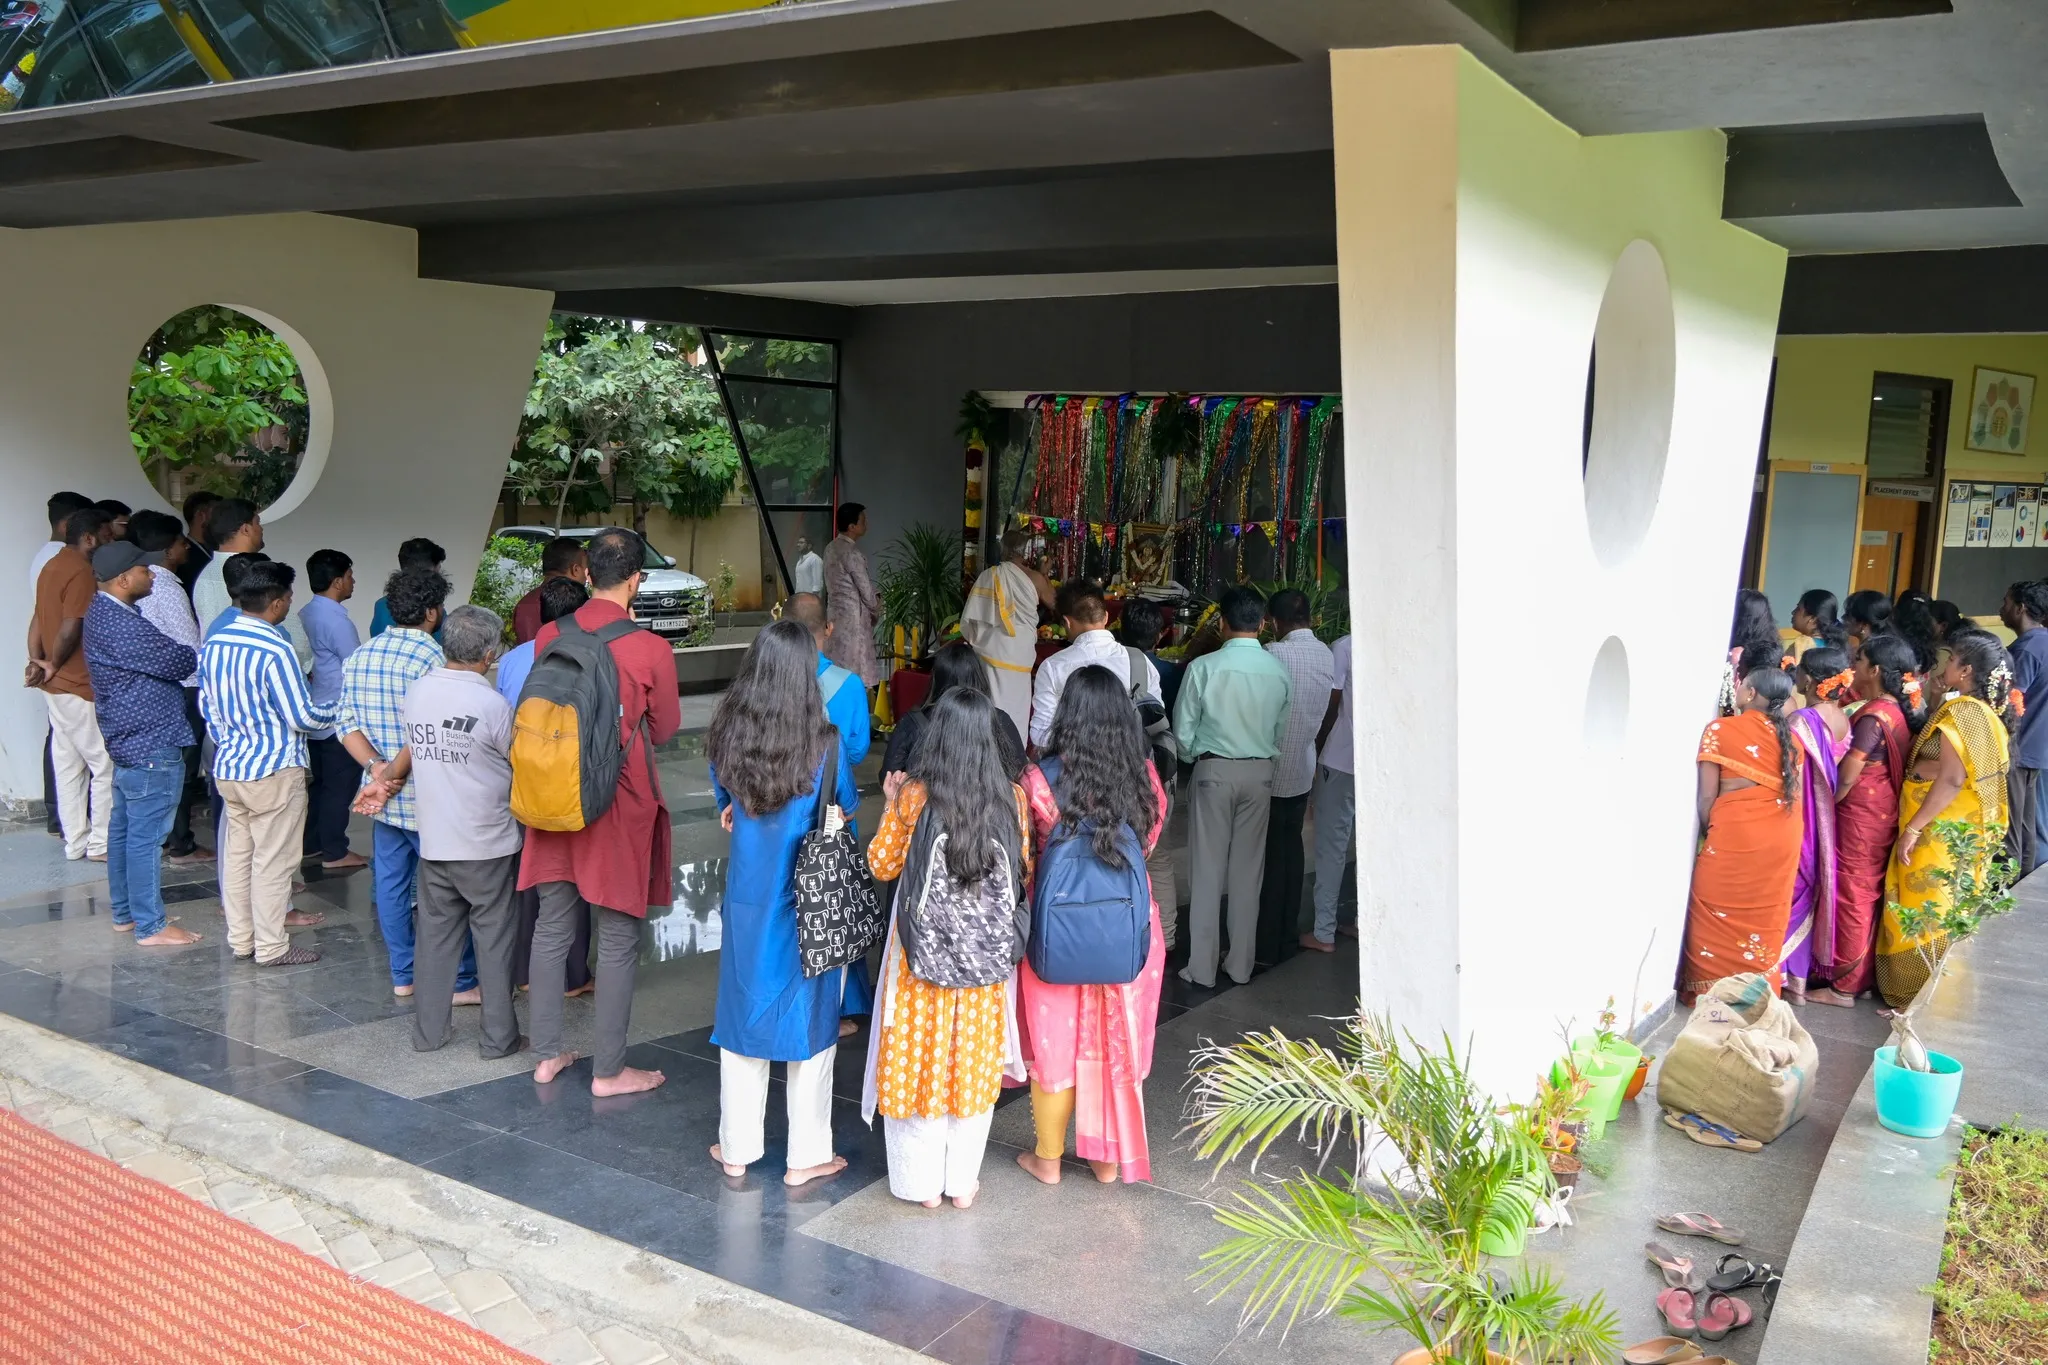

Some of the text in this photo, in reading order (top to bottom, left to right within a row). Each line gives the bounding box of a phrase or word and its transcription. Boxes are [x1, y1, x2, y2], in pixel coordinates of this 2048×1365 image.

[1874, 486, 1902, 495] PLACEMENT
[1902, 489, 1920, 497] OFFICE
[406, 722, 437, 745] NSB
[446, 738, 472, 749] School
